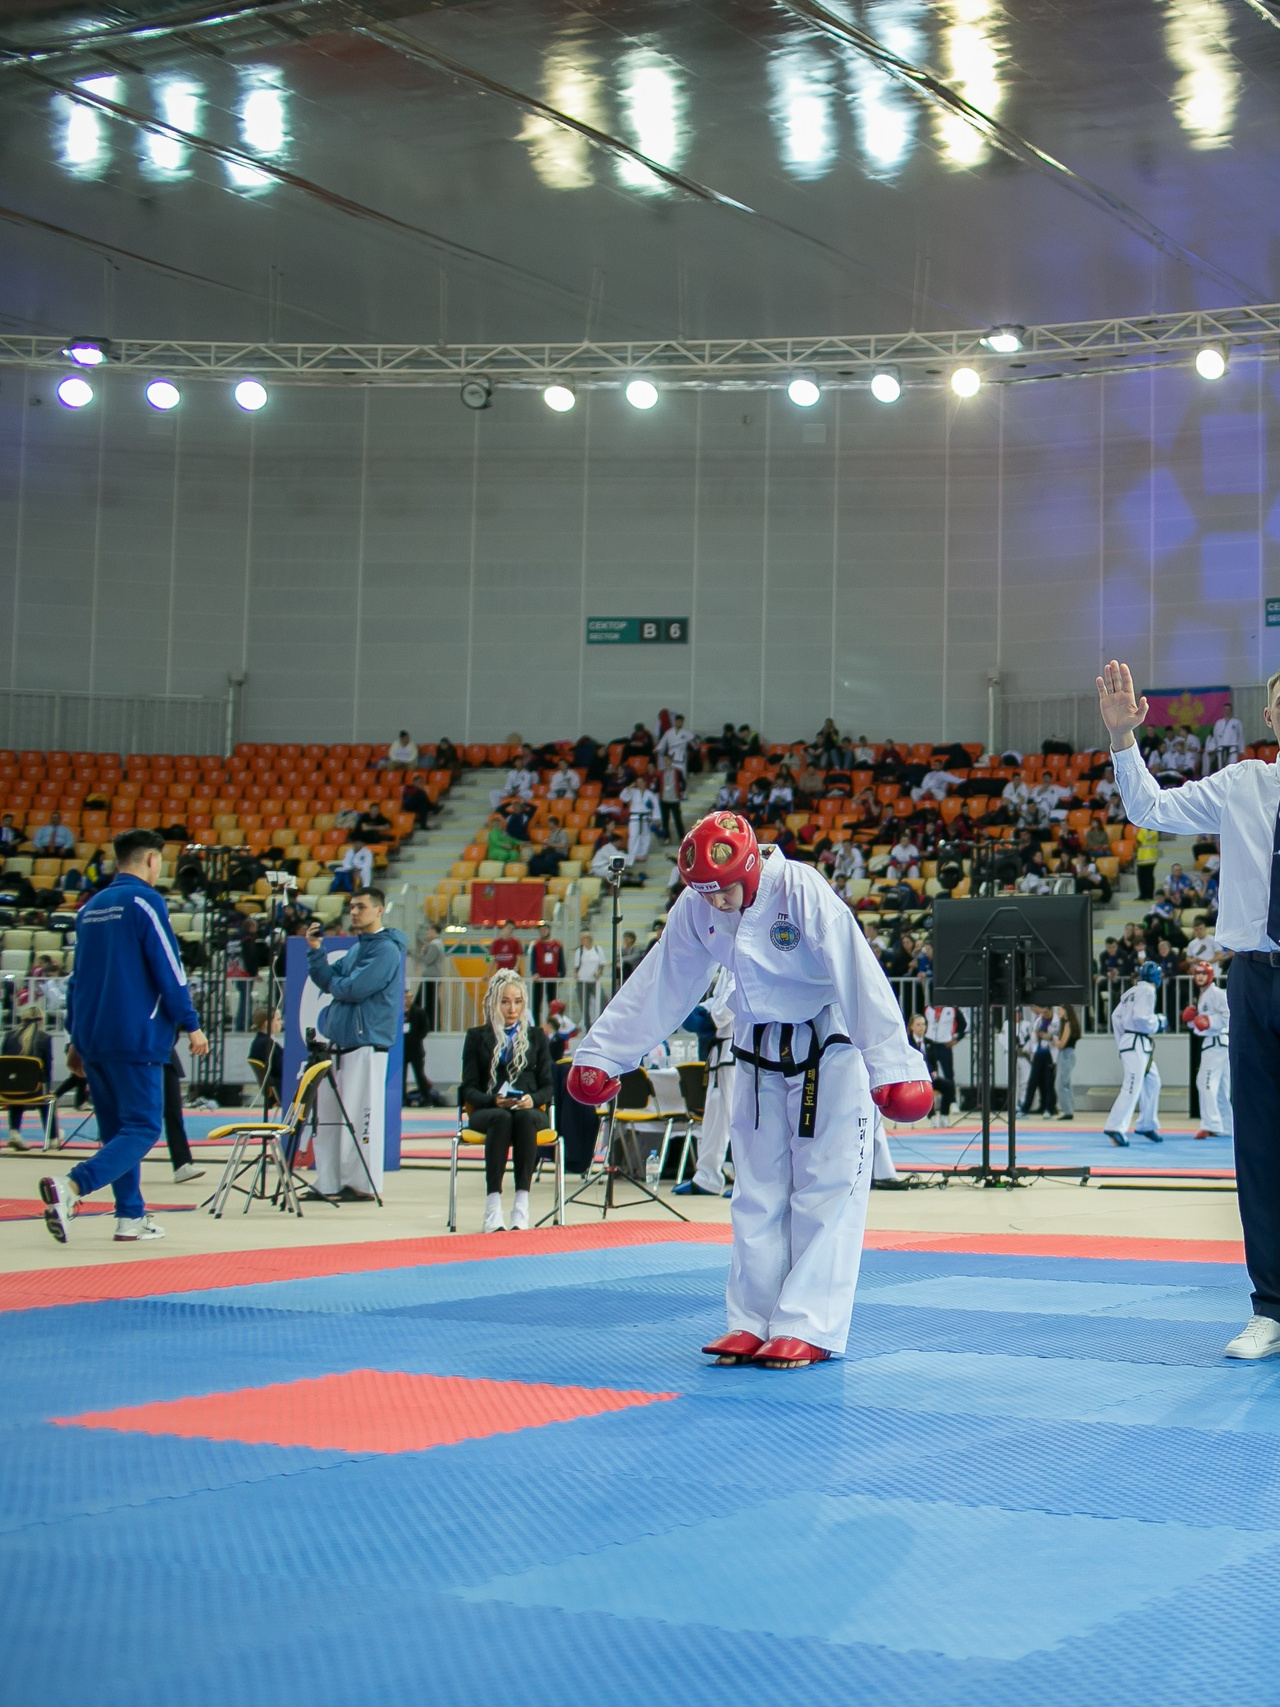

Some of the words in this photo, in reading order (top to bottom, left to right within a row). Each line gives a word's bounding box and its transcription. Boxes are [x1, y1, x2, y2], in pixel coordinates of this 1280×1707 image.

[588, 621, 627, 630] СЕКТОР
[669, 623, 680, 639] 6
[777, 912, 789, 921] ITF
